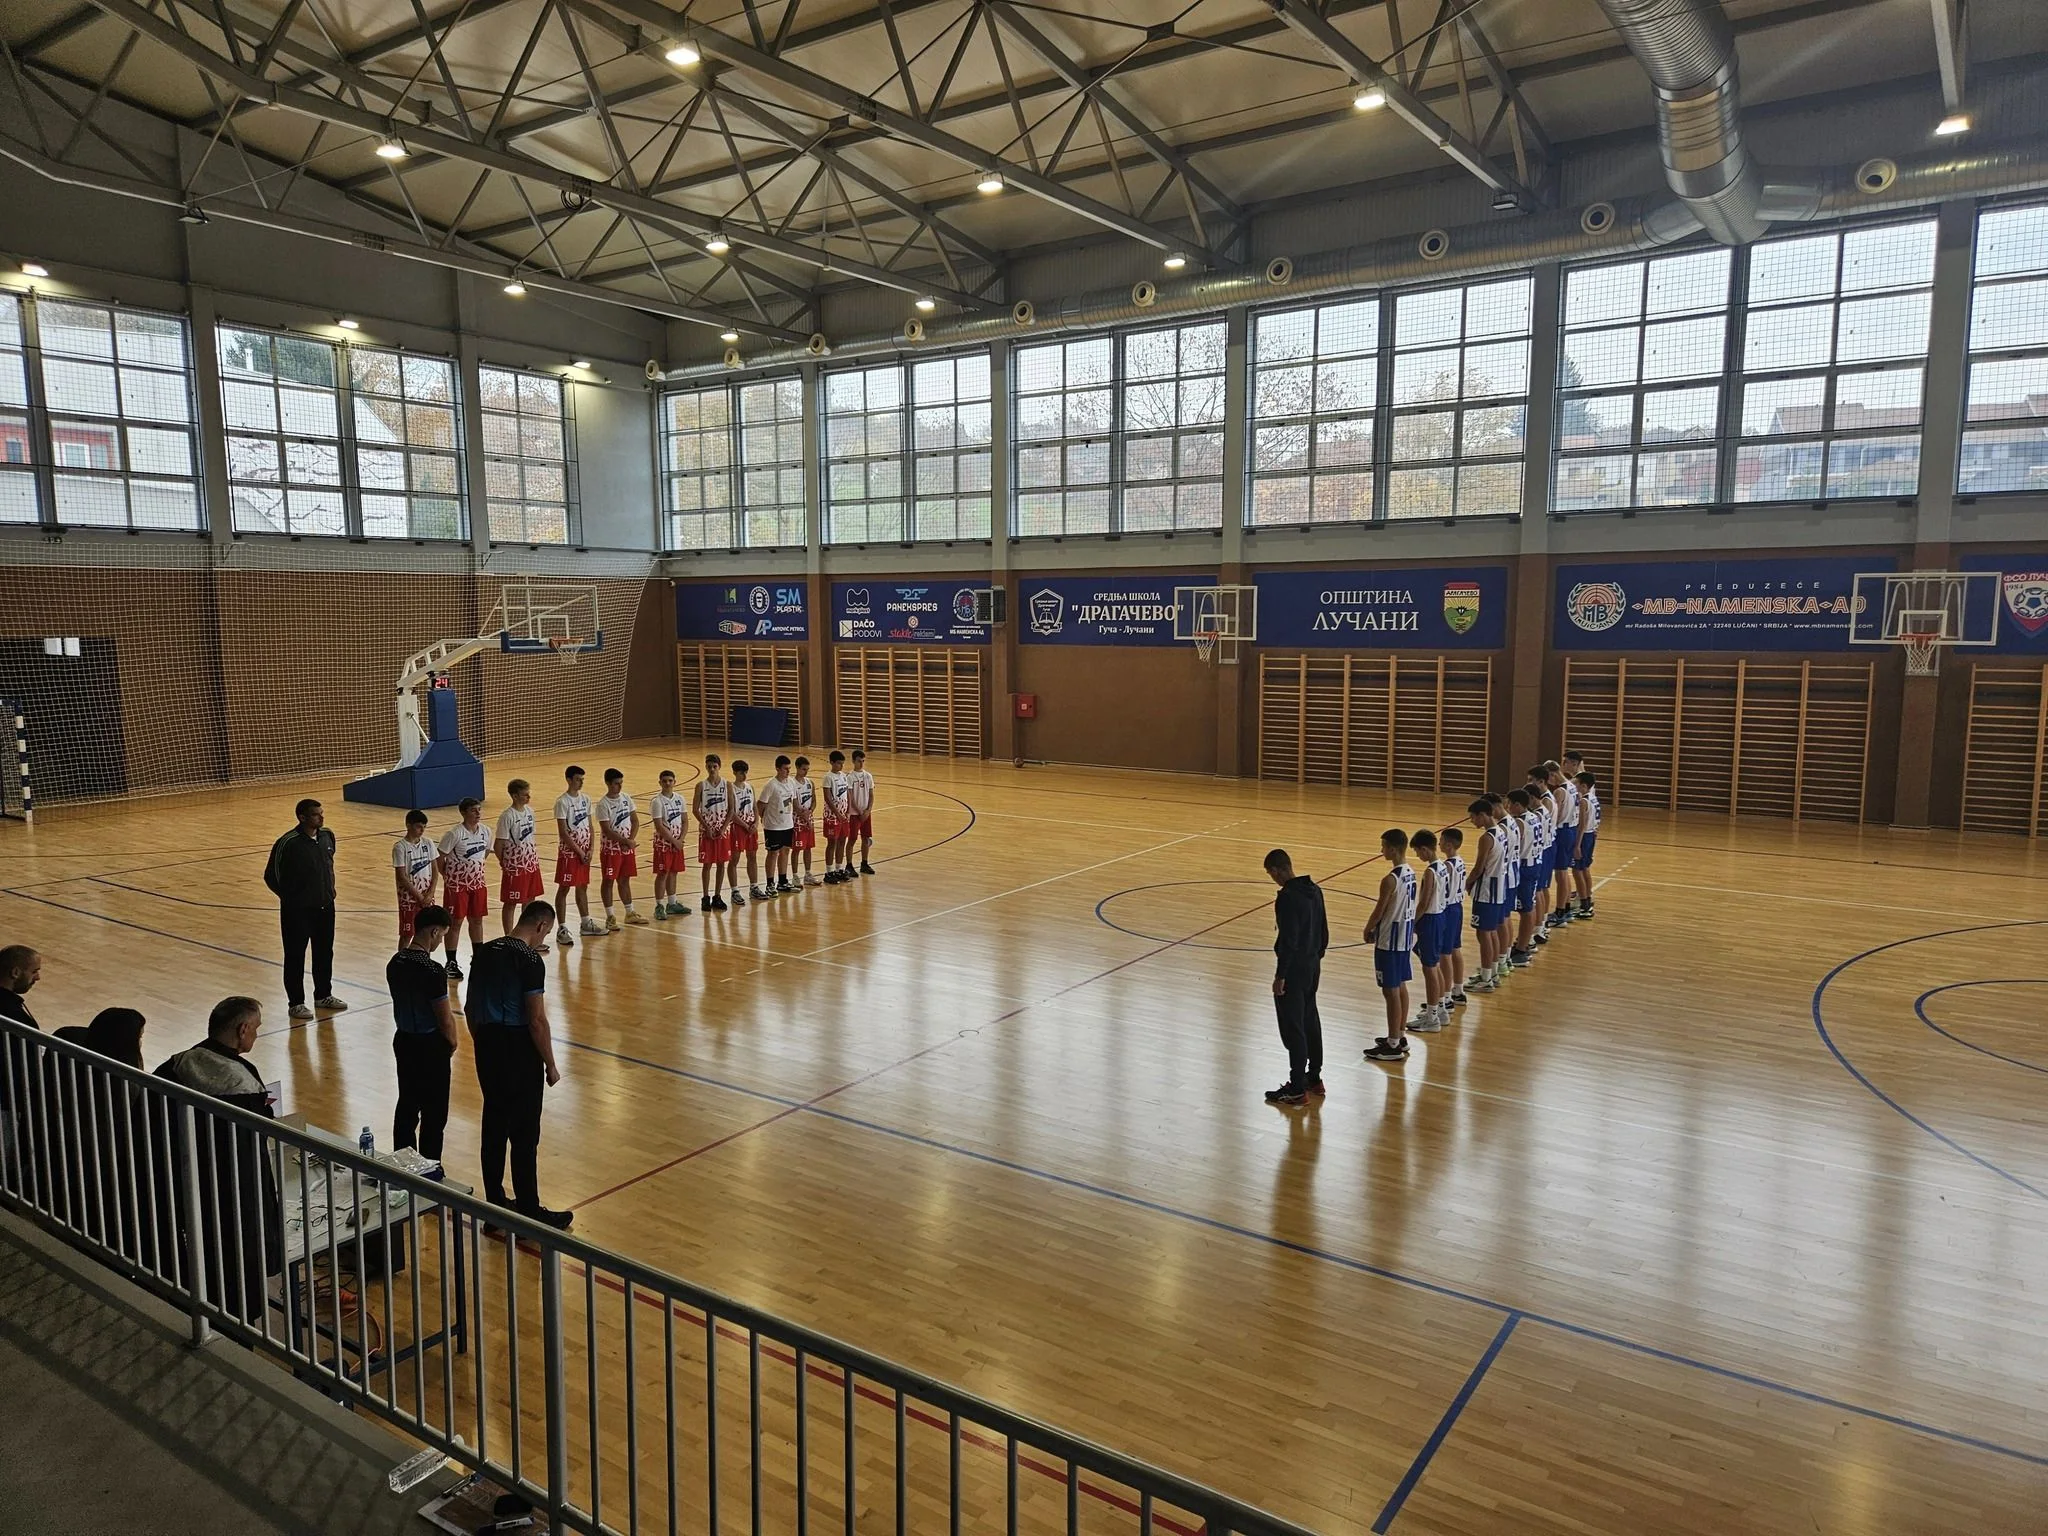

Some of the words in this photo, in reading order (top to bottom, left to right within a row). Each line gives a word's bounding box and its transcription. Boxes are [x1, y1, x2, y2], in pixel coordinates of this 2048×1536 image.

[776, 588, 802, 605] SM
[1093, 592, 1127, 602] СРЕДЊА
[1129, 592, 1160, 601] ШКОЛА
[1320, 590, 1413, 605] ОПШТИНА
[775, 605, 804, 613] PLASTIK
[886, 602, 938, 612] PANEKSPRES
[853, 618, 875, 628] DAČO
[1312, 611, 1420, 631] ЛУЧАНИ
[1732, 621, 1758, 629] LUČANI
[853, 630, 882, 638] PODOVI
[1098, 625, 1118, 635] Гуча
[1123, 625, 1155, 635] Лучани
[435, 678, 448, 689] 24
[509, 891, 520, 900] 20
